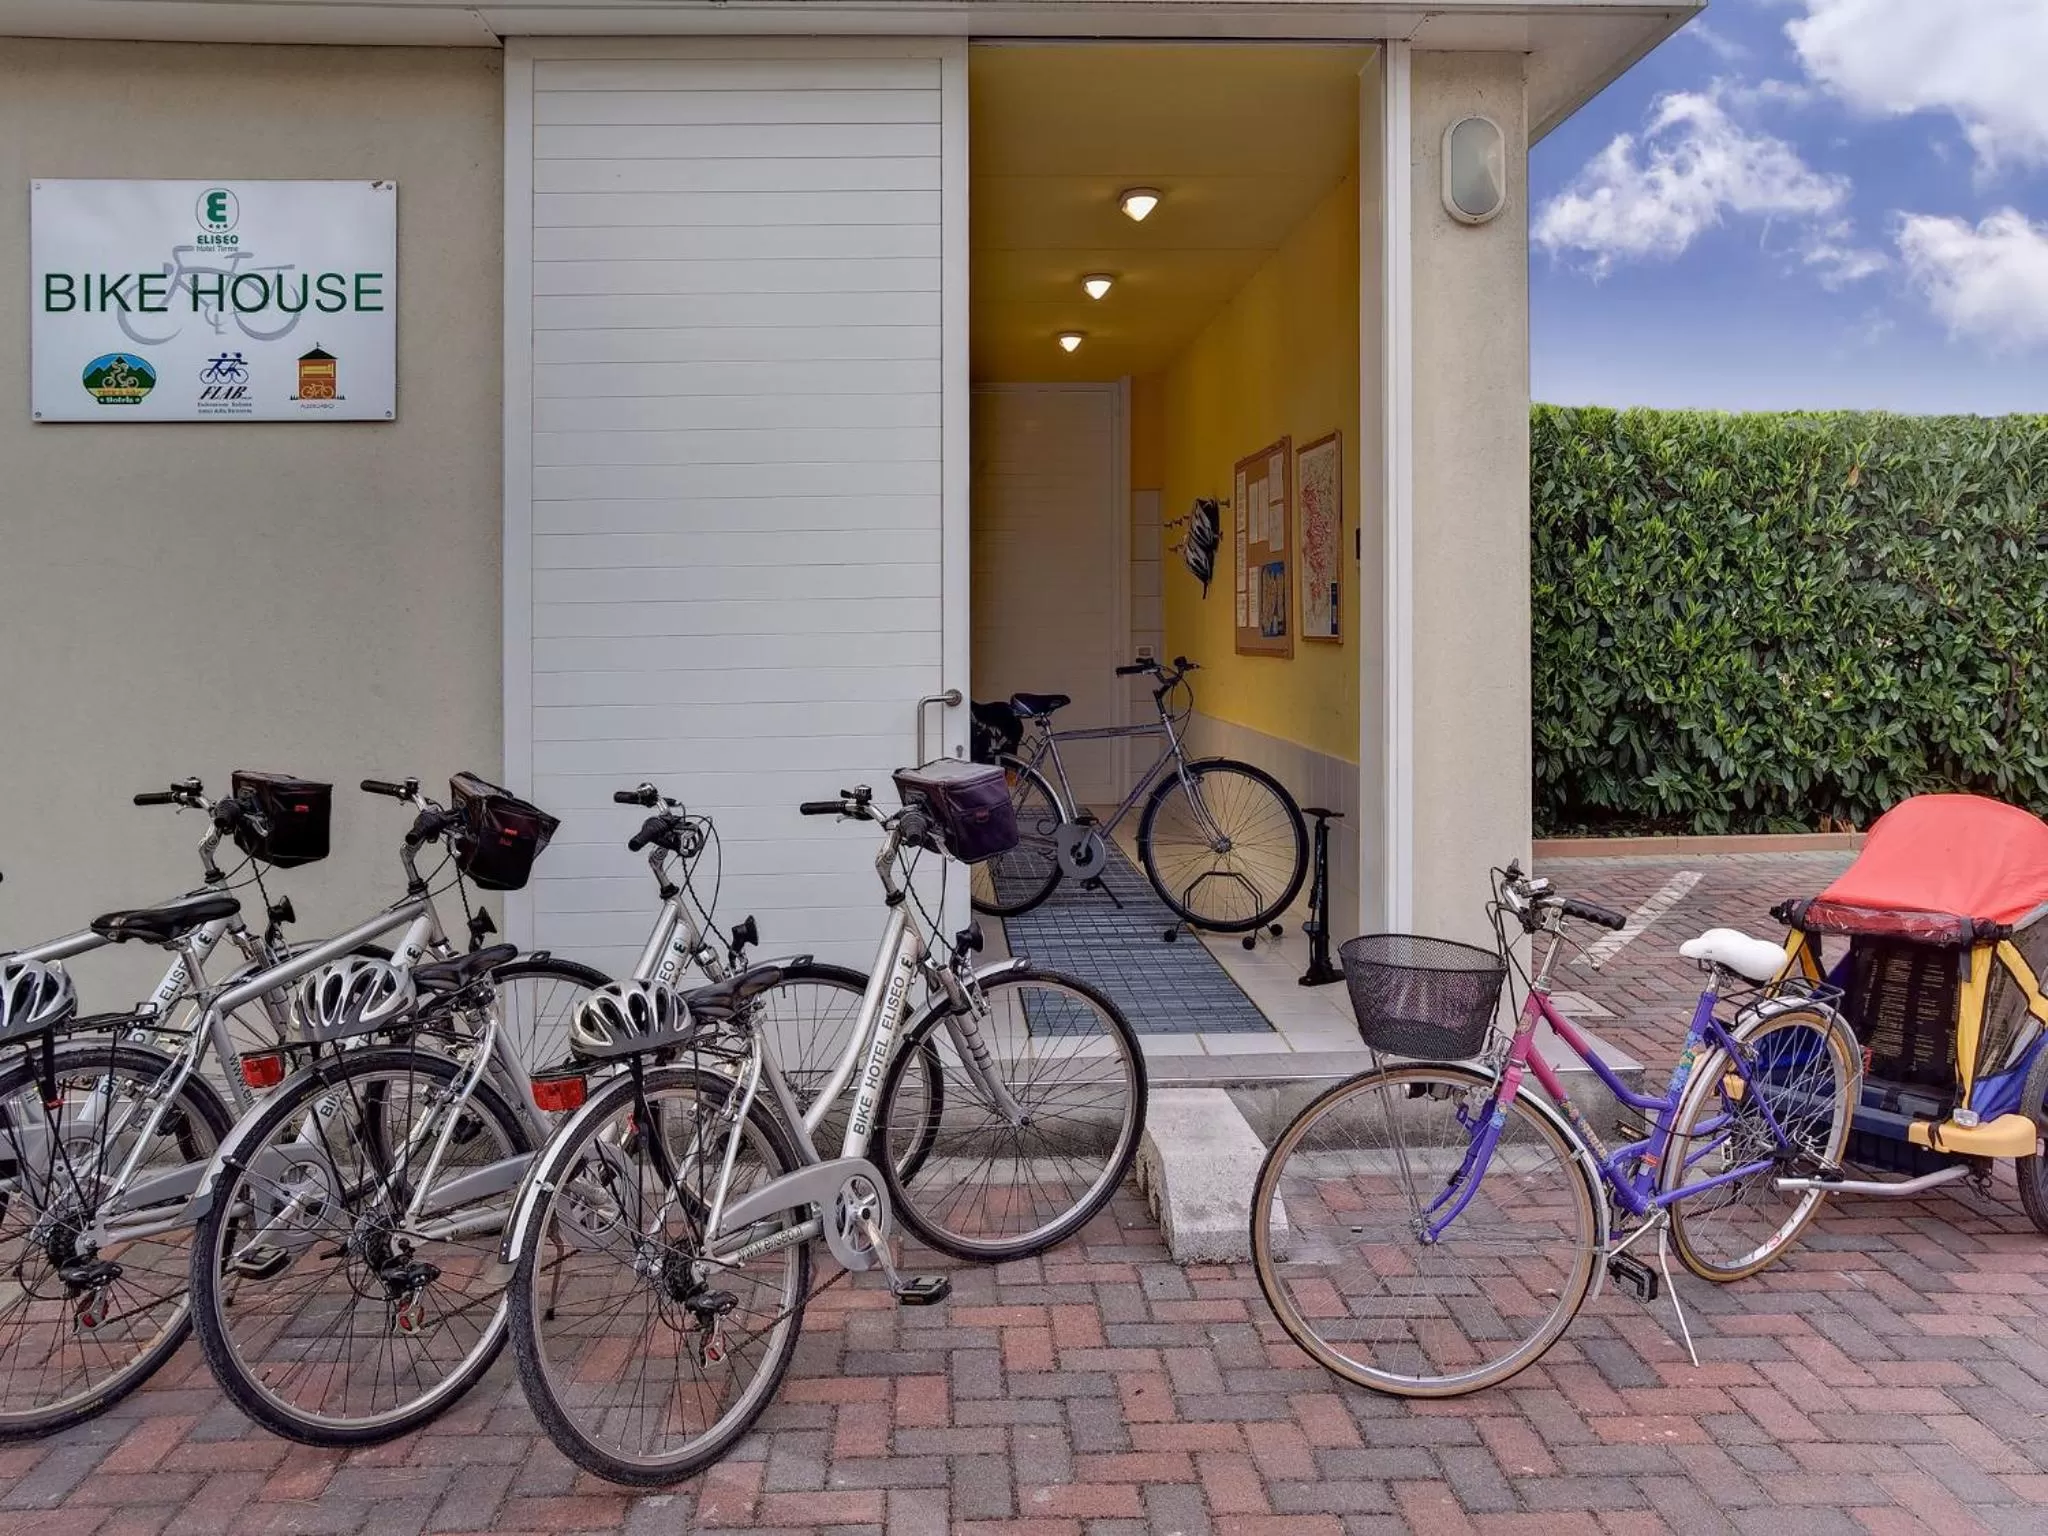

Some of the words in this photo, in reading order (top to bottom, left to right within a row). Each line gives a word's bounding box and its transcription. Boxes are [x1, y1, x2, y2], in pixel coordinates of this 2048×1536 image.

[197, 234, 239, 245] ELISEO
[45, 273, 168, 312] BIKE
[192, 272, 384, 313] HOUSE
[159, 961, 188, 1001] ELISE
[853, 1095, 874, 1136] BIKE
[865, 1039, 889, 1089] HOTEL
[881, 977, 906, 1031] ELISEO
